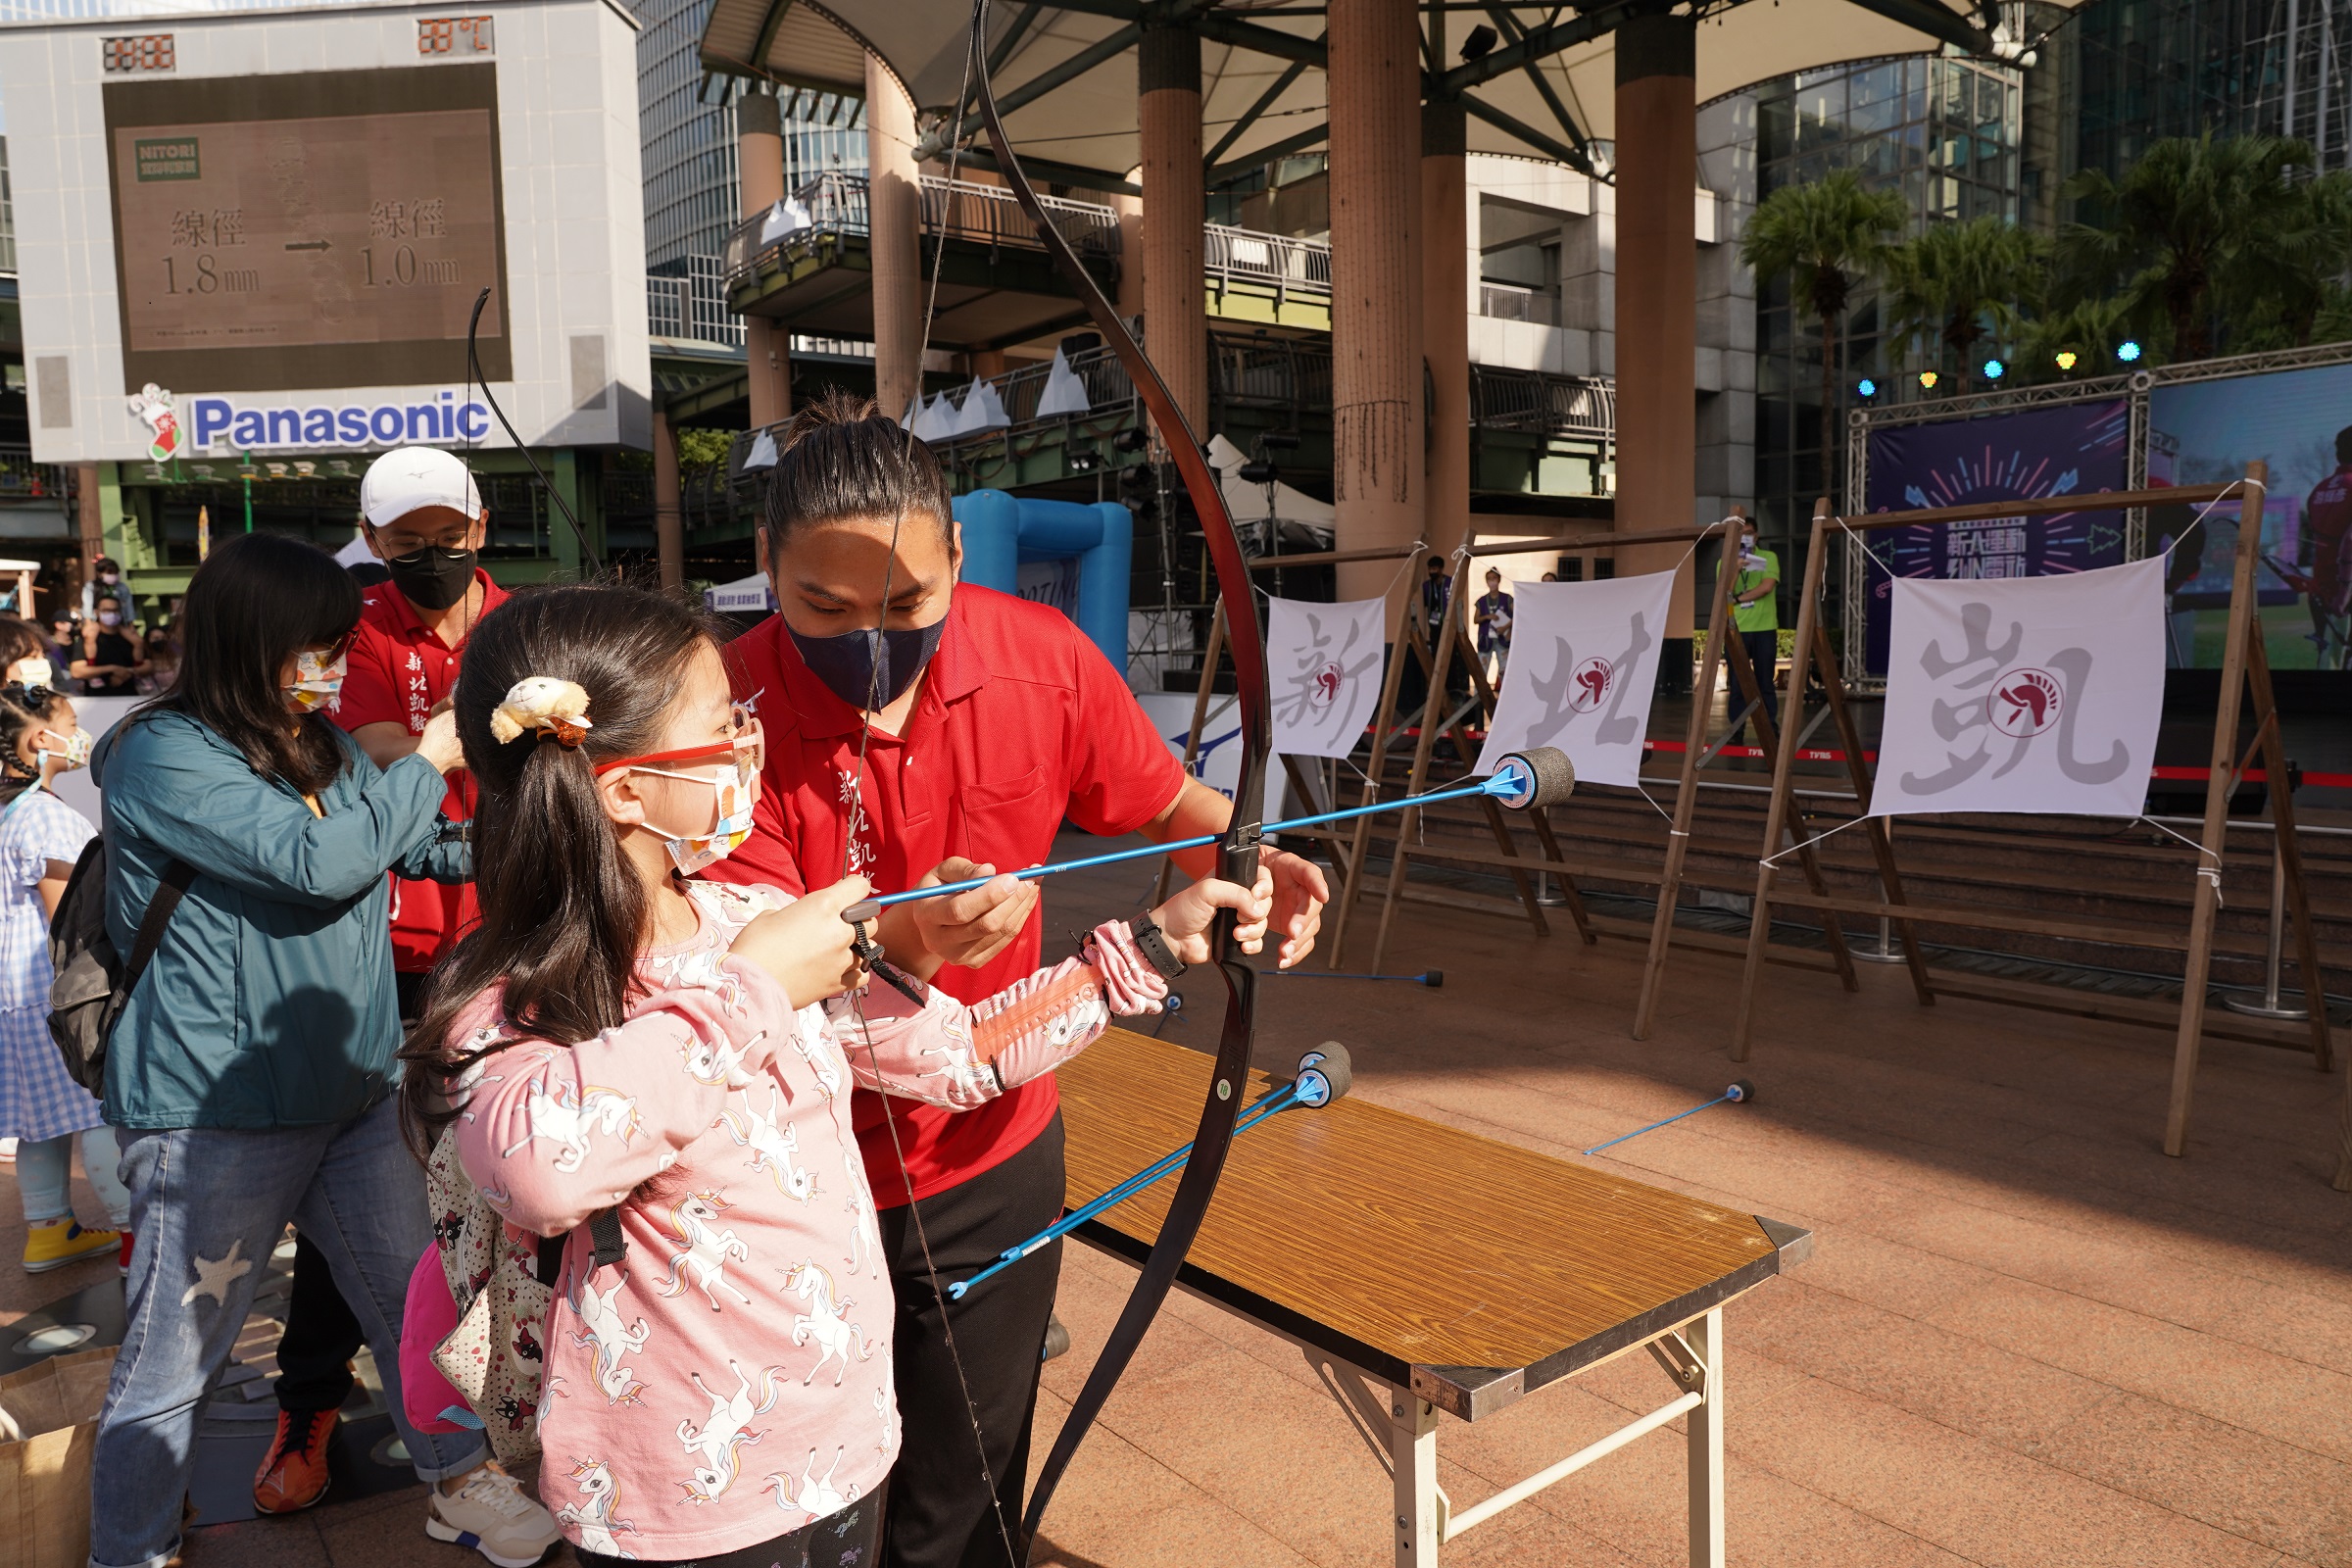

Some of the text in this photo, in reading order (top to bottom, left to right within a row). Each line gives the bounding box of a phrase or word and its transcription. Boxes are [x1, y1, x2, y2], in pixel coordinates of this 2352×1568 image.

[140, 144, 195, 160] NITORI
[172, 209, 245, 247] 線徑
[370, 199, 446, 238] 線徑
[194, 390, 489, 446] Panasonic
[1271, 612, 1379, 750] 新
[1525, 611, 1651, 750] 北
[1899, 602, 2131, 796] 凱
